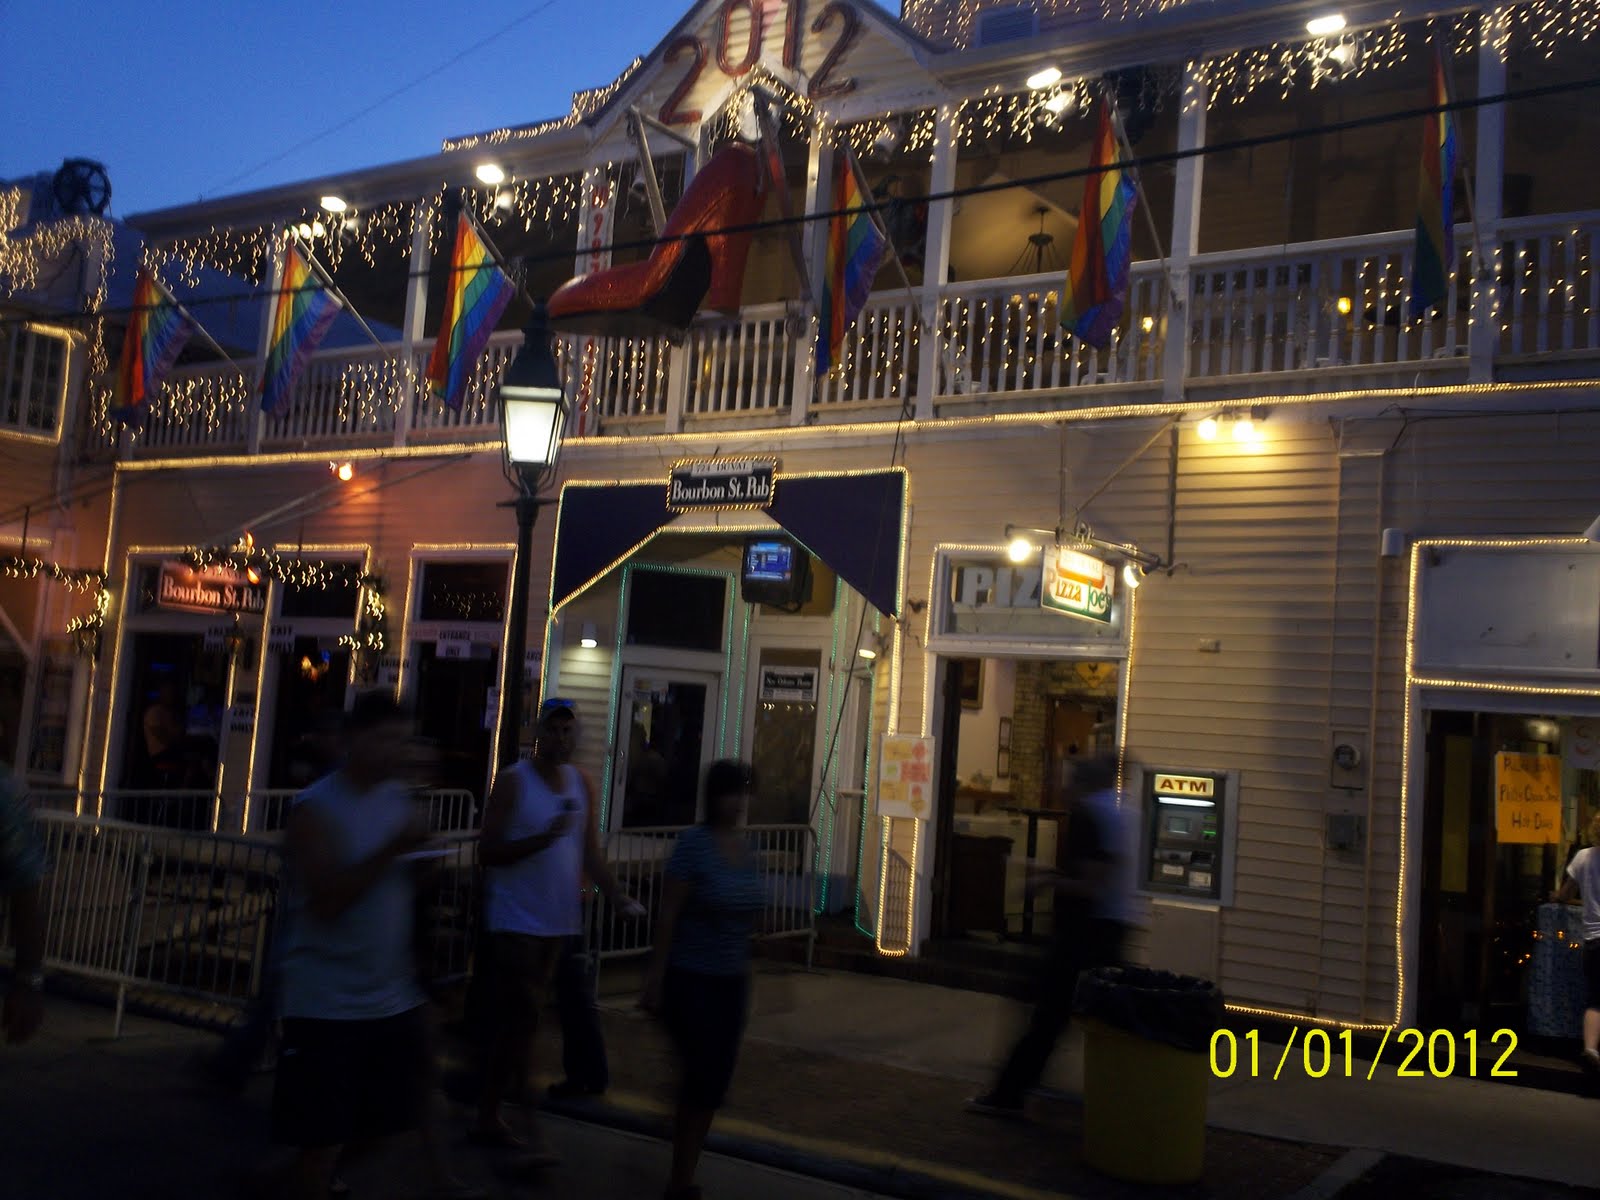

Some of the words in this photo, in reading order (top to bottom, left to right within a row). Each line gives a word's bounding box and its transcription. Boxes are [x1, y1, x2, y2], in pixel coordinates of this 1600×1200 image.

[658, 0, 858, 125] 2012
[671, 478, 725, 501] Bourbon
[727, 476, 744, 498] St.
[745, 475, 770, 499] Pub
[161, 575, 221, 606] Bourbon
[222, 584, 240, 611] St.
[961, 566, 1042, 609] PIZ
[1045, 567, 1082, 602] Pizza
[1160, 779, 1207, 793] ATM
